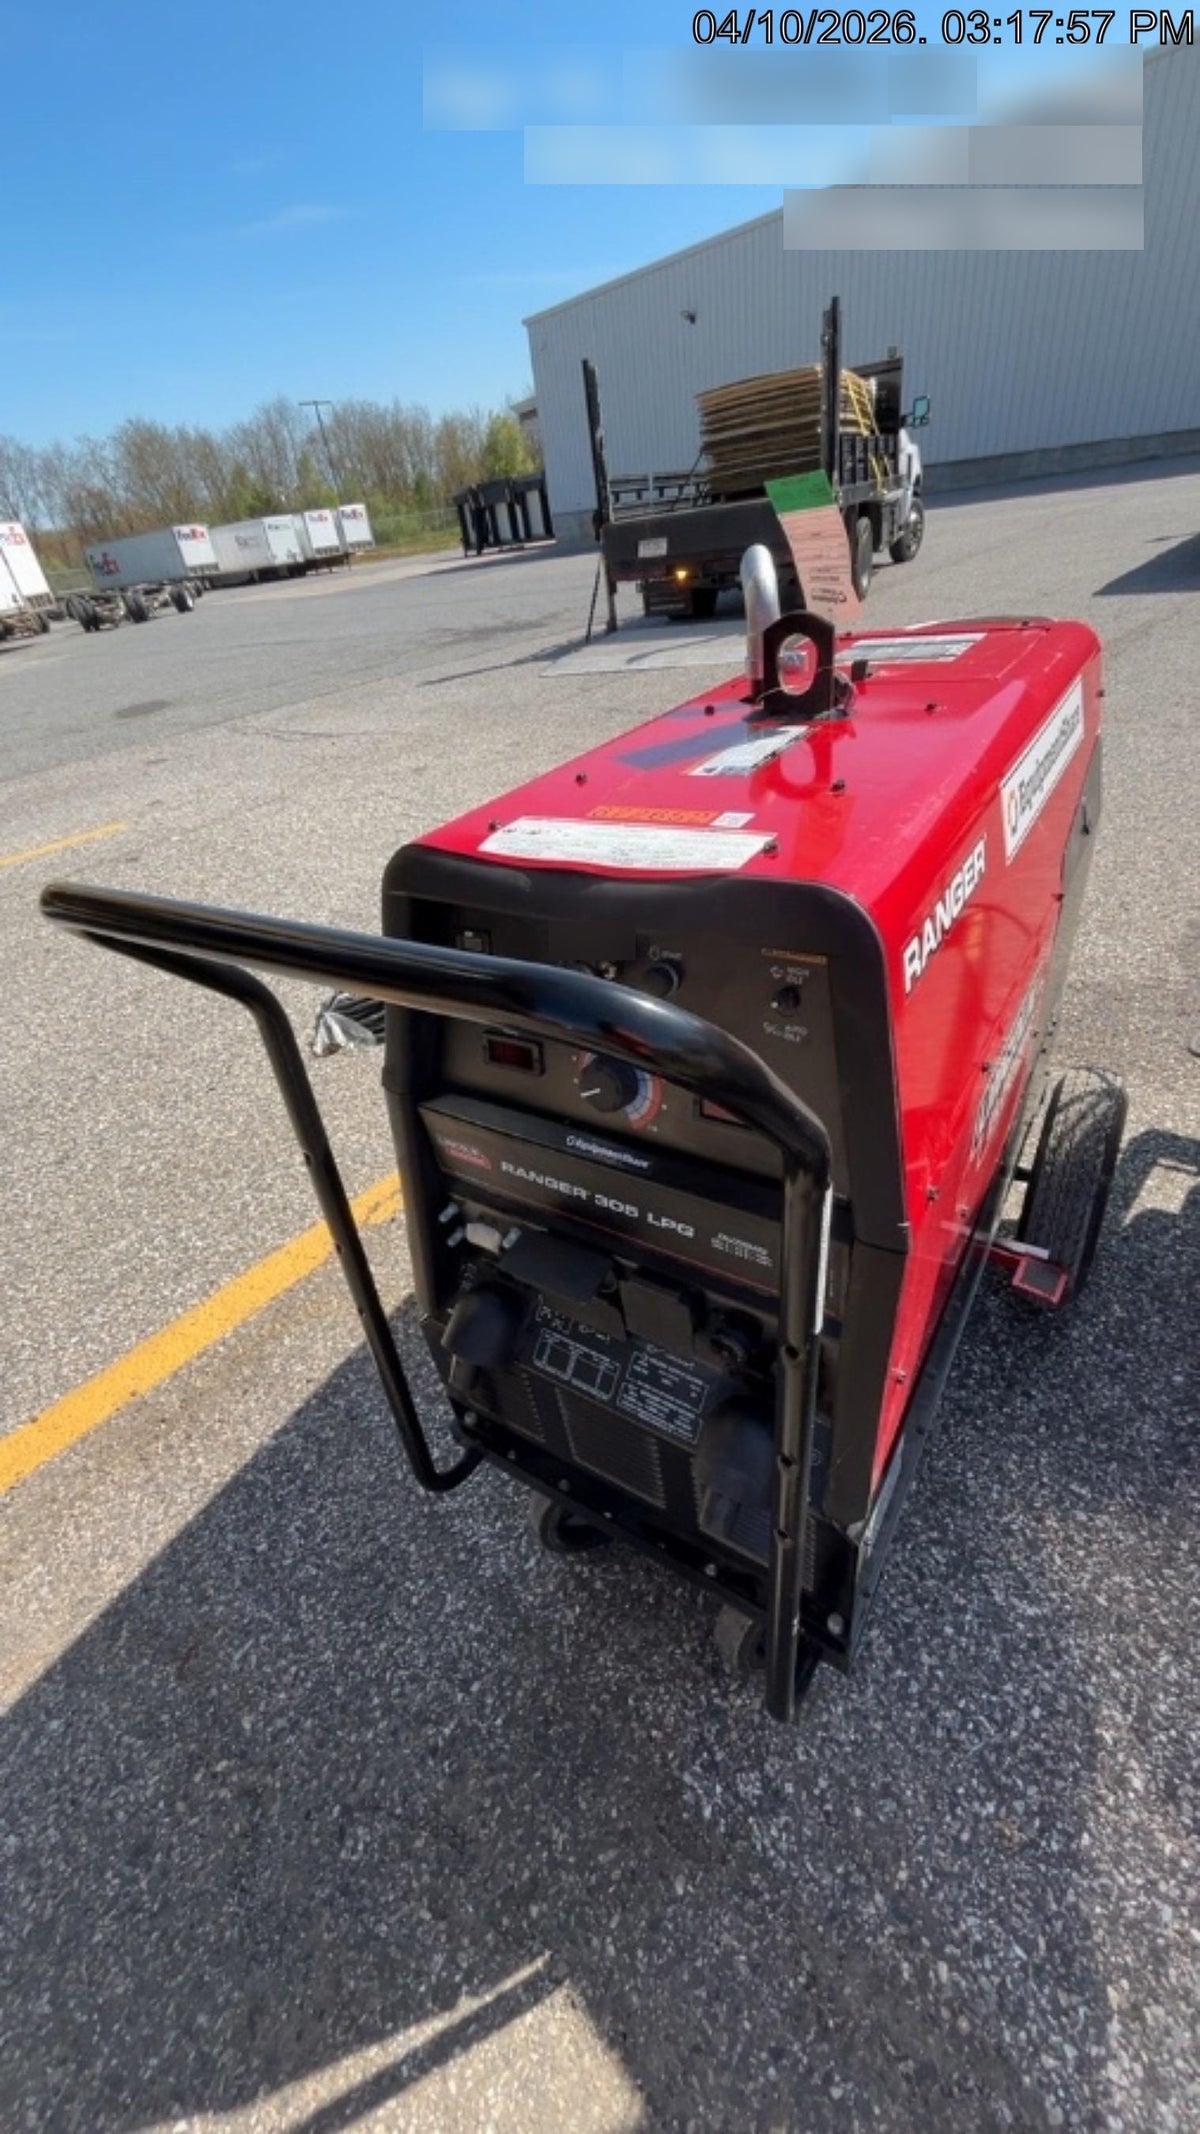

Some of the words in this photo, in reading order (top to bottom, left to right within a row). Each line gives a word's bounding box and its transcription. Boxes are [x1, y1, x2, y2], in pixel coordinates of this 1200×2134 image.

[902, 838, 987, 995] RANGER
[500, 1161, 588, 1201] RANGER
[594, 1193, 640, 1219] 305
[647, 1212, 696, 1239] LPG
